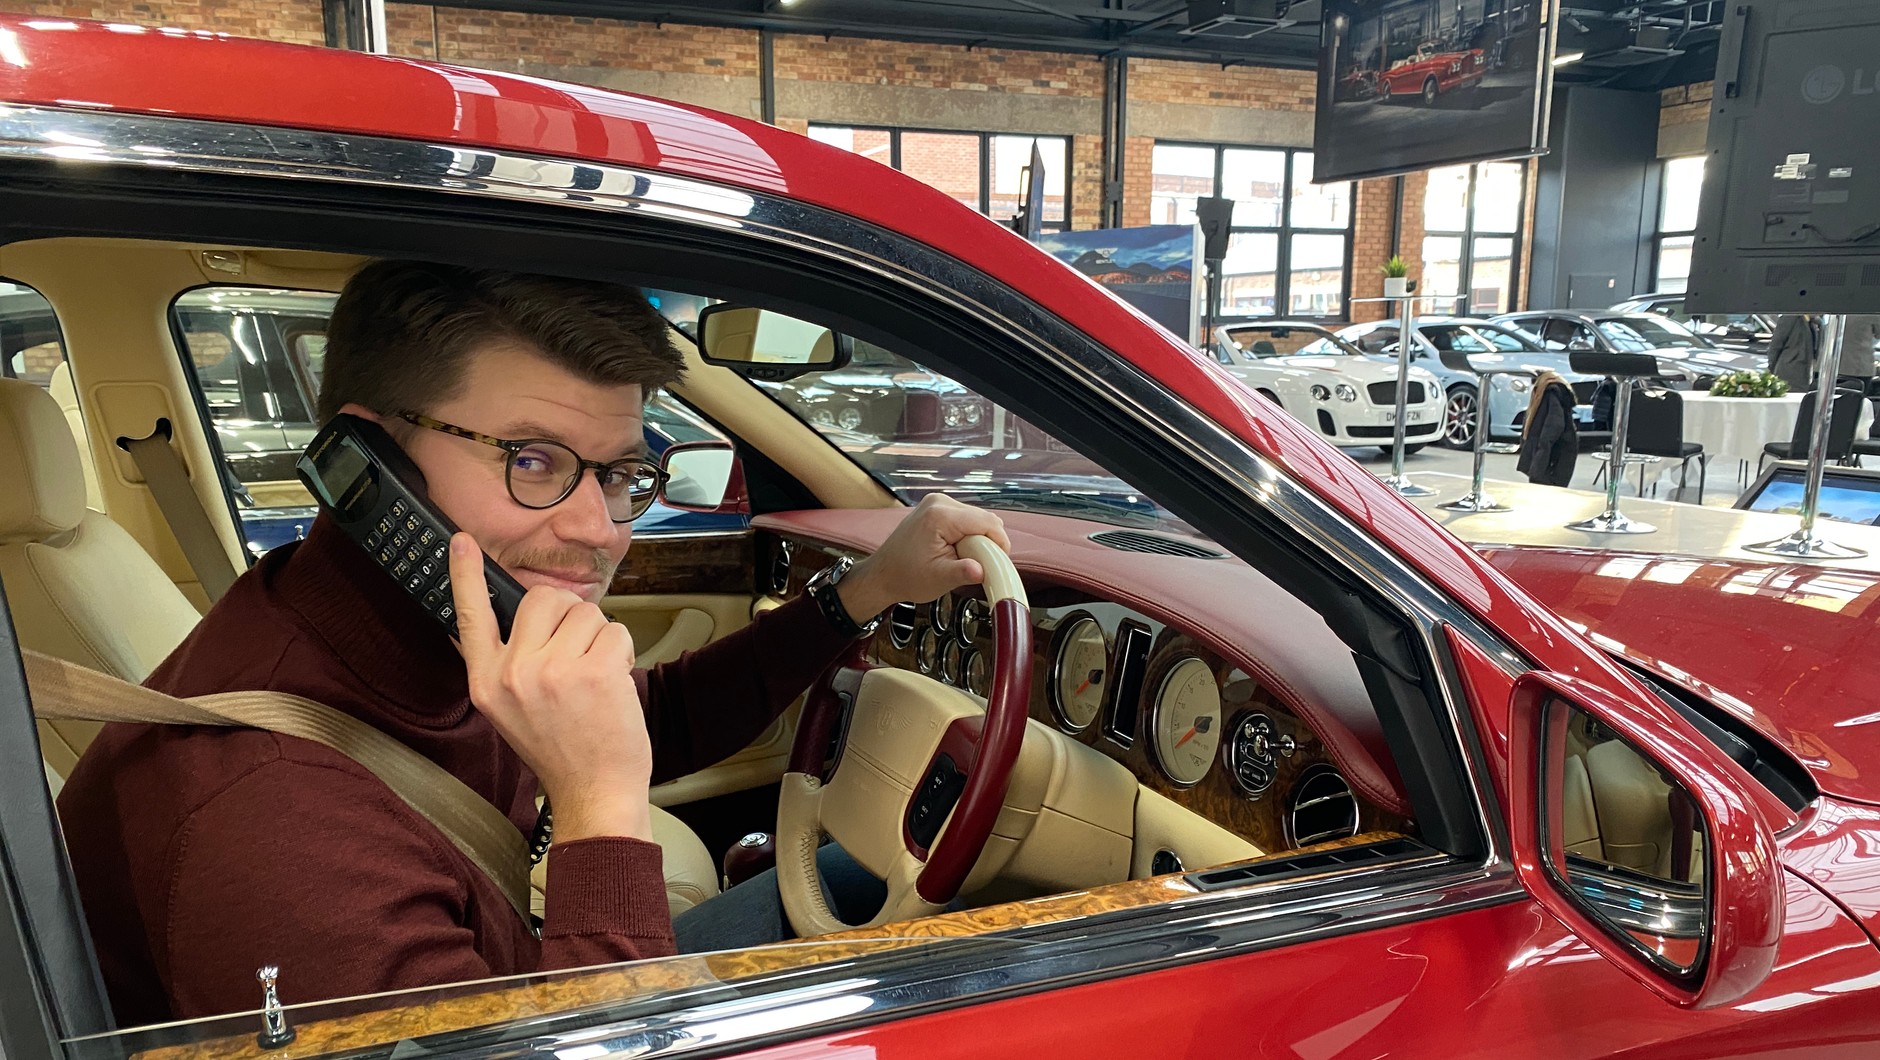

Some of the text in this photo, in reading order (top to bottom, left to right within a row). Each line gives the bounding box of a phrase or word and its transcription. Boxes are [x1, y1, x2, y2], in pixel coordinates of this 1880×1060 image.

[1853, 68, 1880, 96] L
[380, 523, 388, 533] 2
[392, 506, 401, 516] 3
[393, 536, 401, 547] 5
[406, 521, 415, 530] 6
[407, 551, 415, 561] 8
[420, 535, 429, 545] 9
